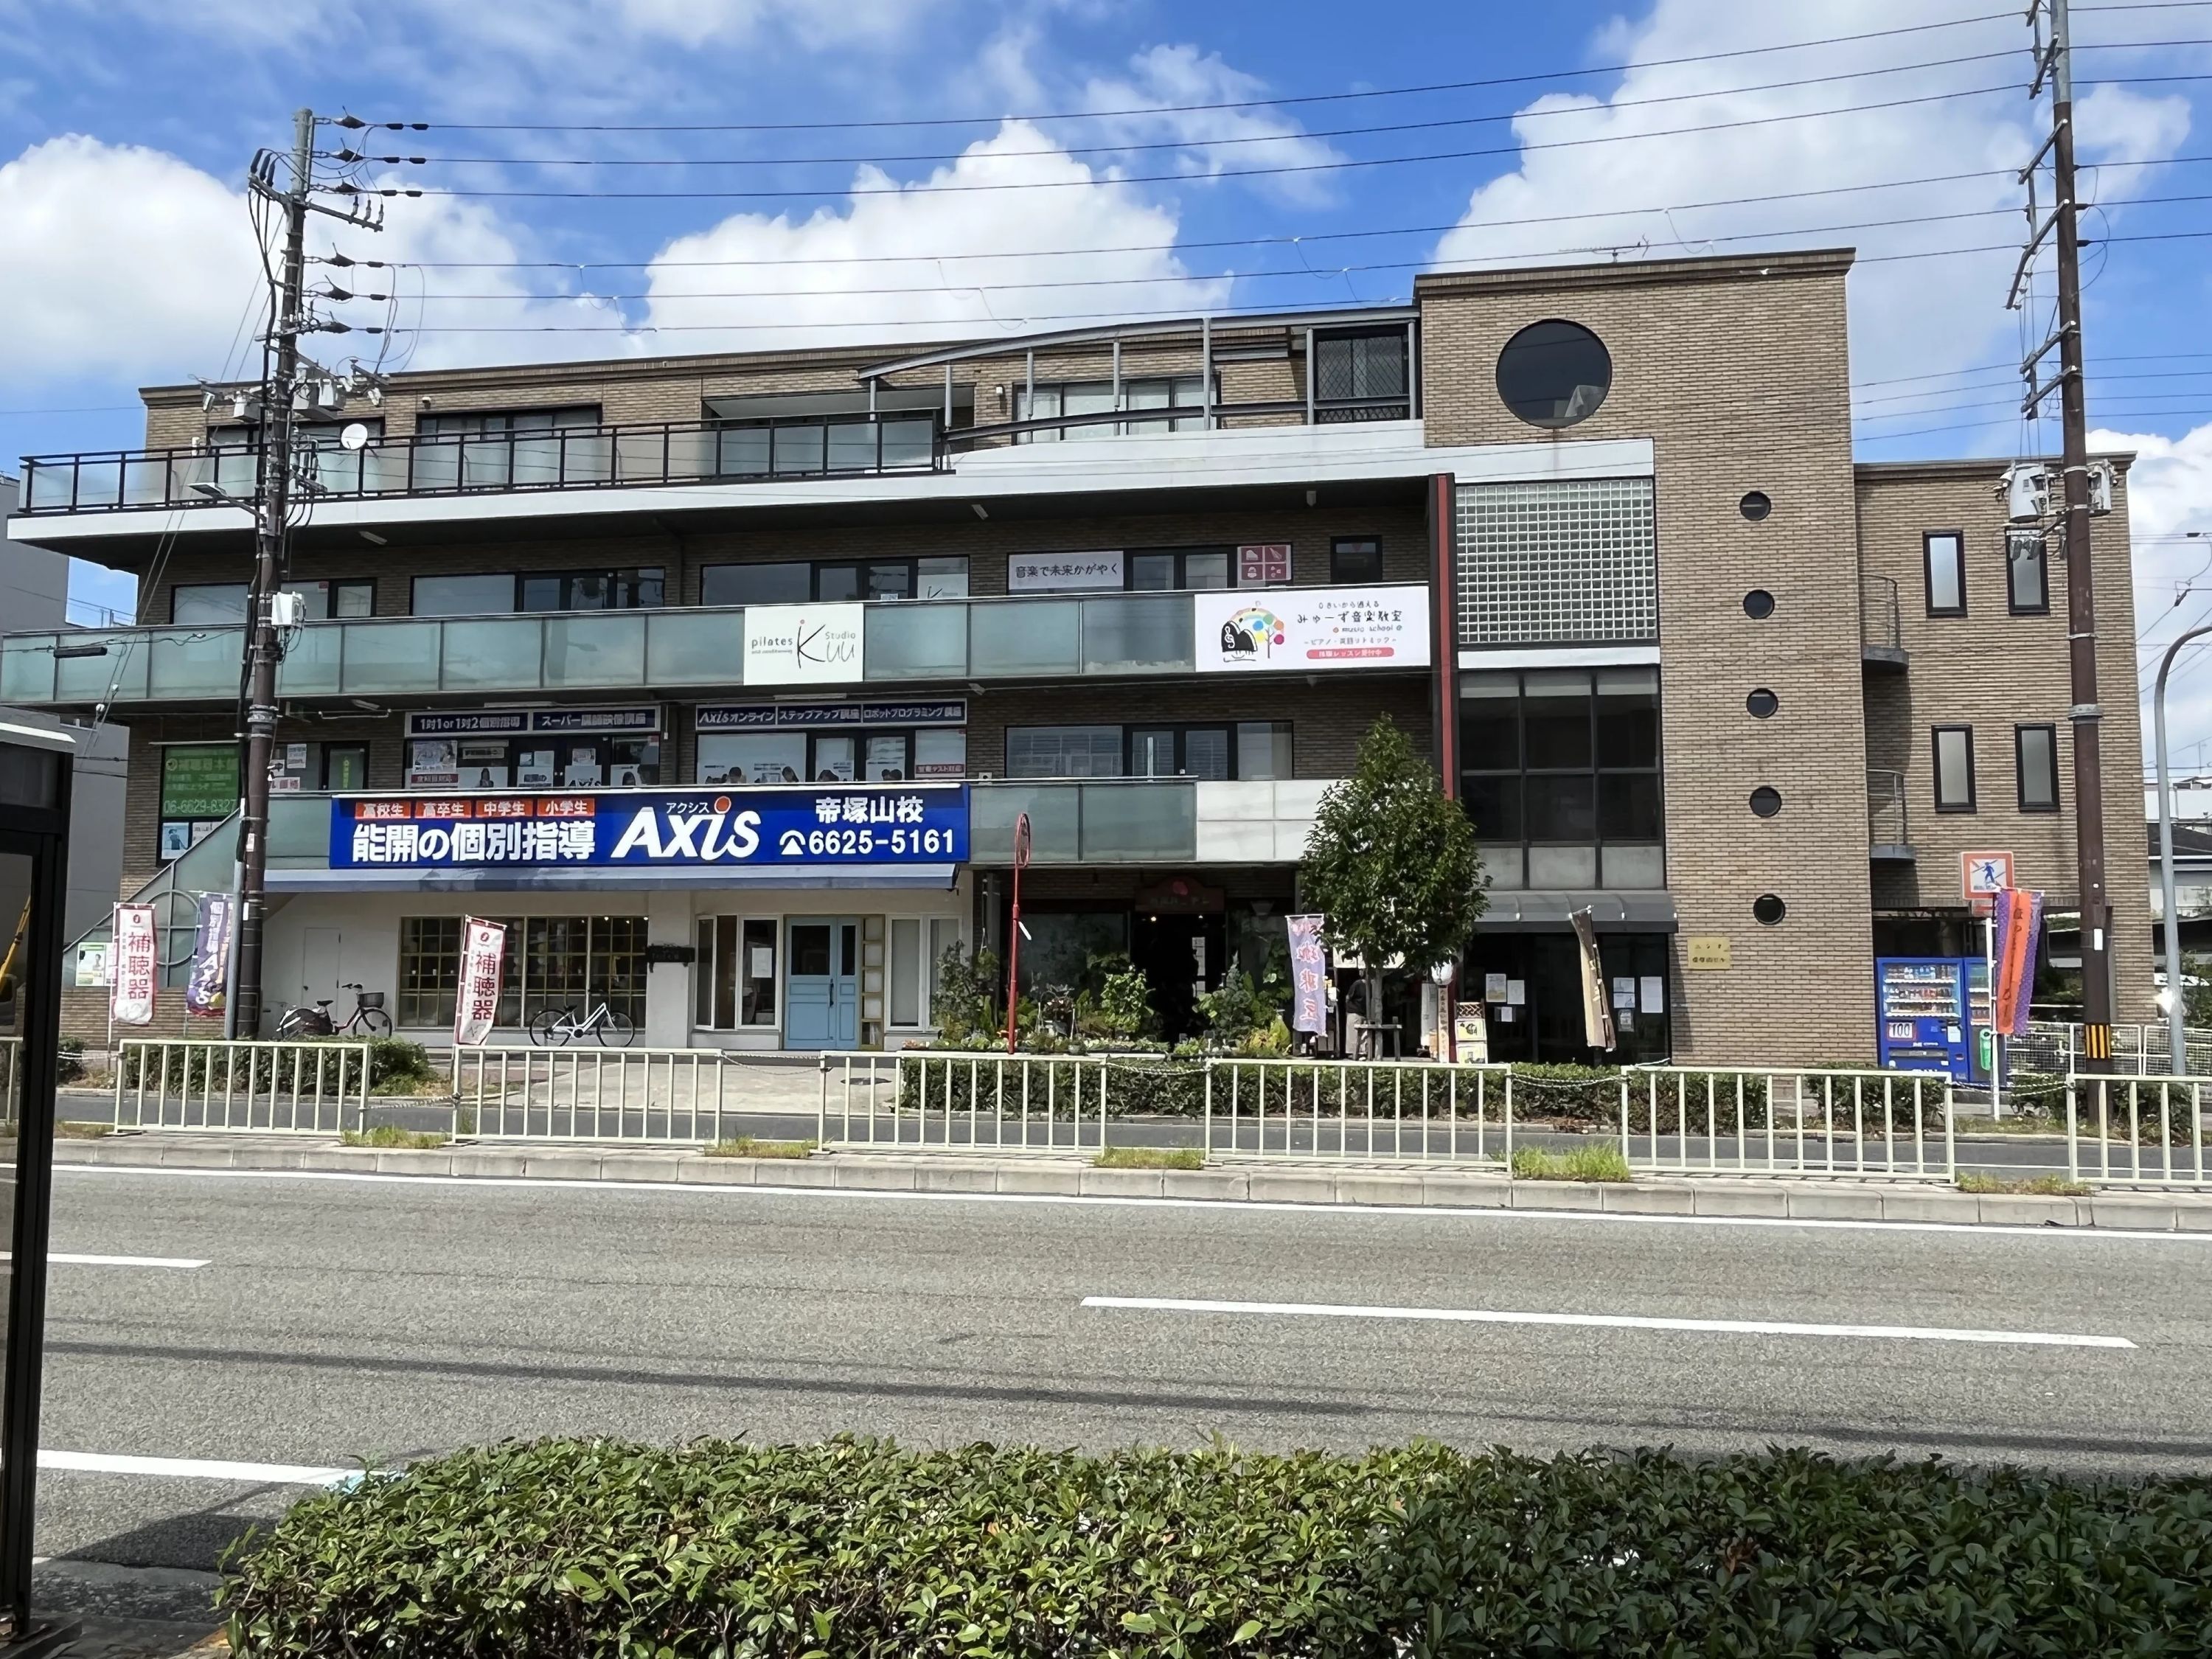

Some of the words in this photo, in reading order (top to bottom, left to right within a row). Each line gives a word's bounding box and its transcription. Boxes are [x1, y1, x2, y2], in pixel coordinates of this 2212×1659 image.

[751, 636, 793, 649] pilates
[825, 630, 856, 640] Studio
[363, 802, 405, 818] 高校生
[422, 801, 465, 817] 高卒生
[483, 801, 525, 817] 中学生
[545, 800, 588, 816] 小学生
[666, 801, 710, 814] アクシス
[815, 796, 924, 824] 帝塚山校
[352, 821, 596, 863] 能開の個別指導
[809, 828, 954, 855] 6625-5161
[128, 931, 151, 1001] 補聴器
[472, 950, 497, 1021] 補聴器
[1891, 1023, 1910, 1037] 100
